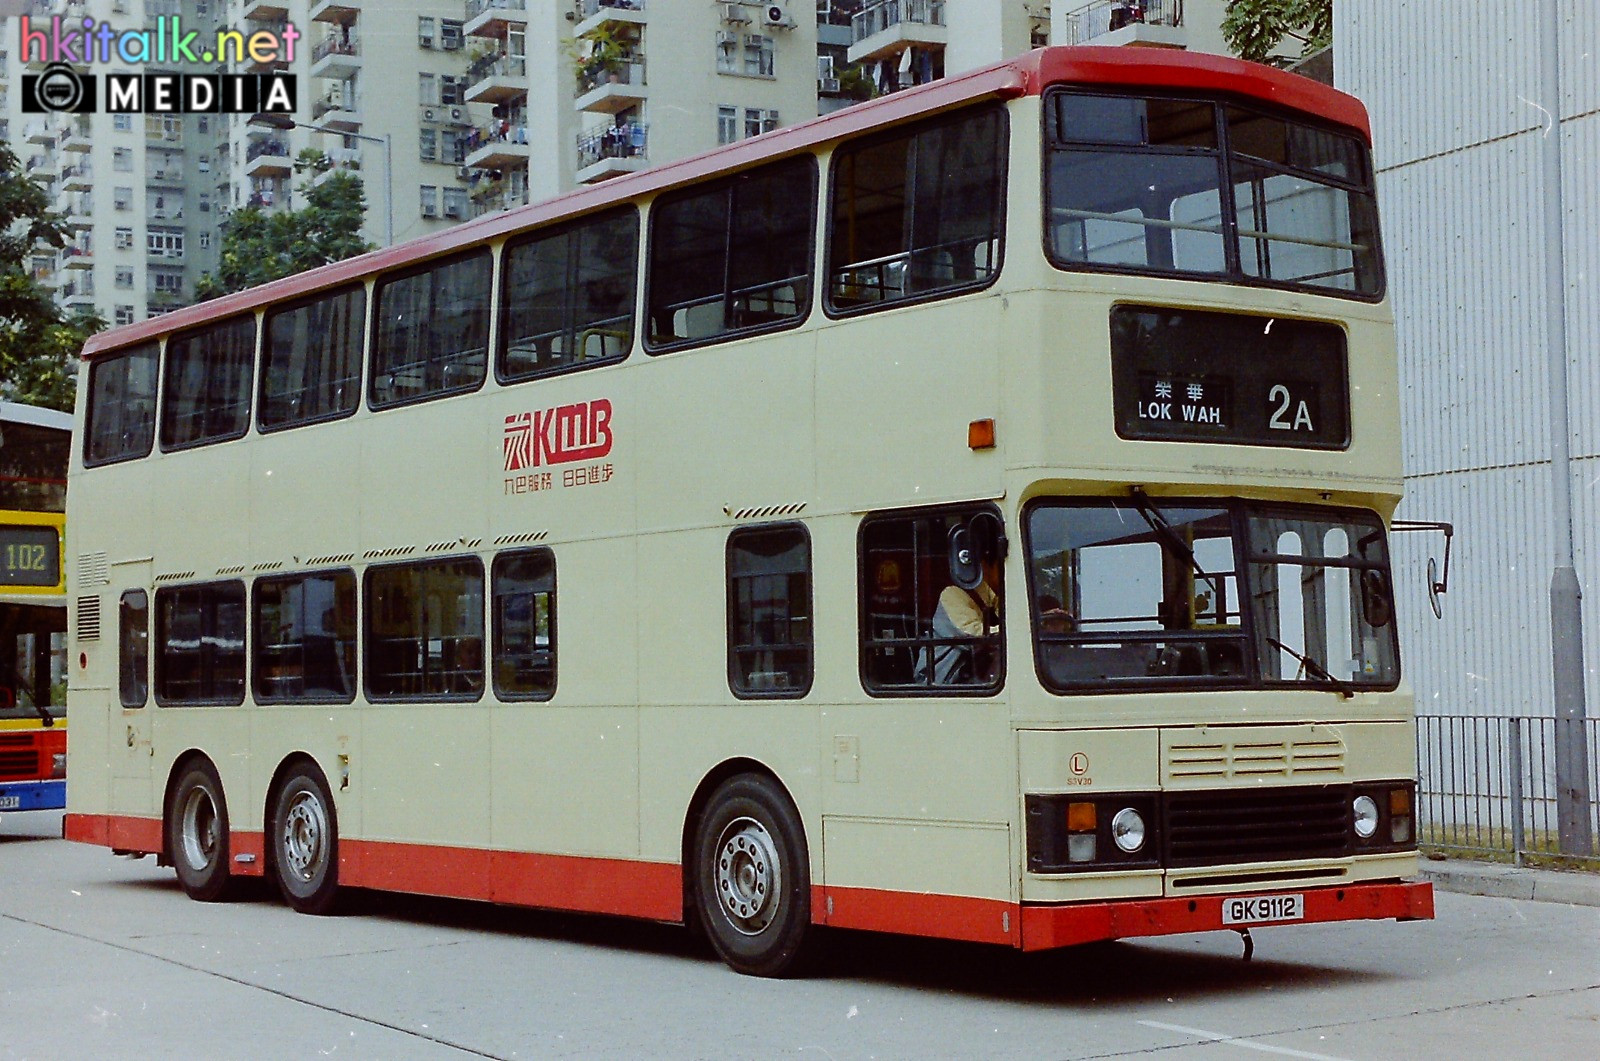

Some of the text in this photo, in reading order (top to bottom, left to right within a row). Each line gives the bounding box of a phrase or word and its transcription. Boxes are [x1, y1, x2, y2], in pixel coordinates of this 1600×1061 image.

[1138, 401, 1221, 424] LOK WAH
[1268, 384, 1314, 431] 2A
[7, 544, 46, 571] 102
